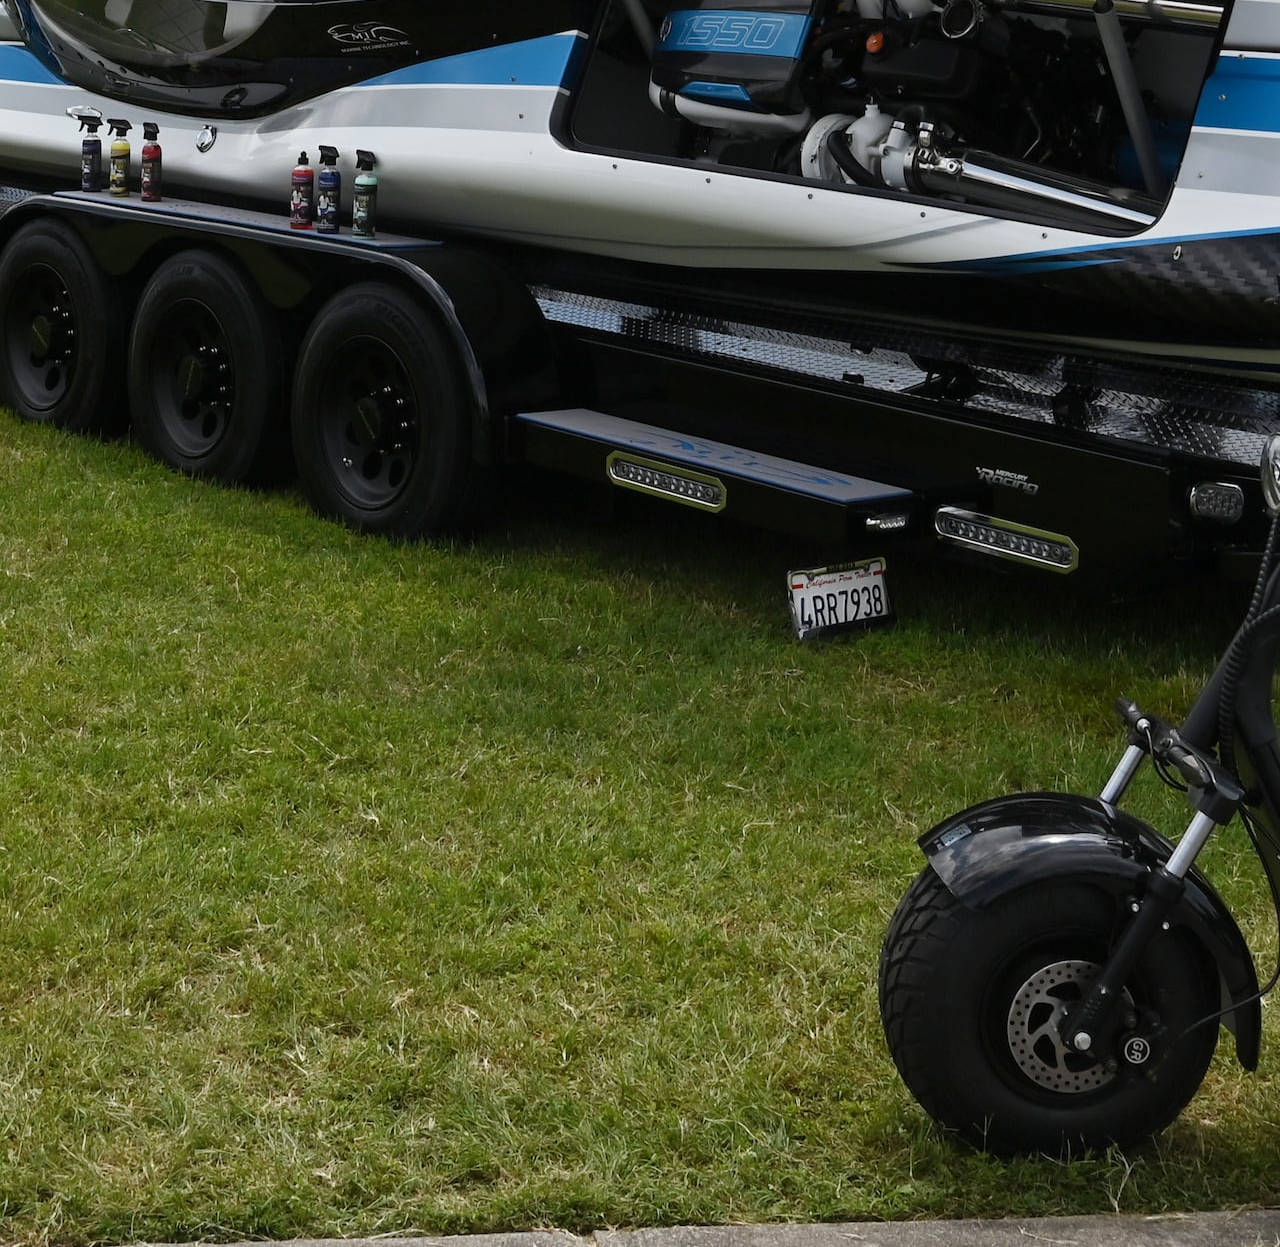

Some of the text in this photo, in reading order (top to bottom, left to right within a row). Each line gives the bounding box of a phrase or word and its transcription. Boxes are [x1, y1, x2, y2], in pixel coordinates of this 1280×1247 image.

[676, 15, 785, 49] 1550
[976, 467, 1039, 495] Racing
[995, 469, 1028, 481] MERCURY
[800, 584, 883, 629] 4RR7938
